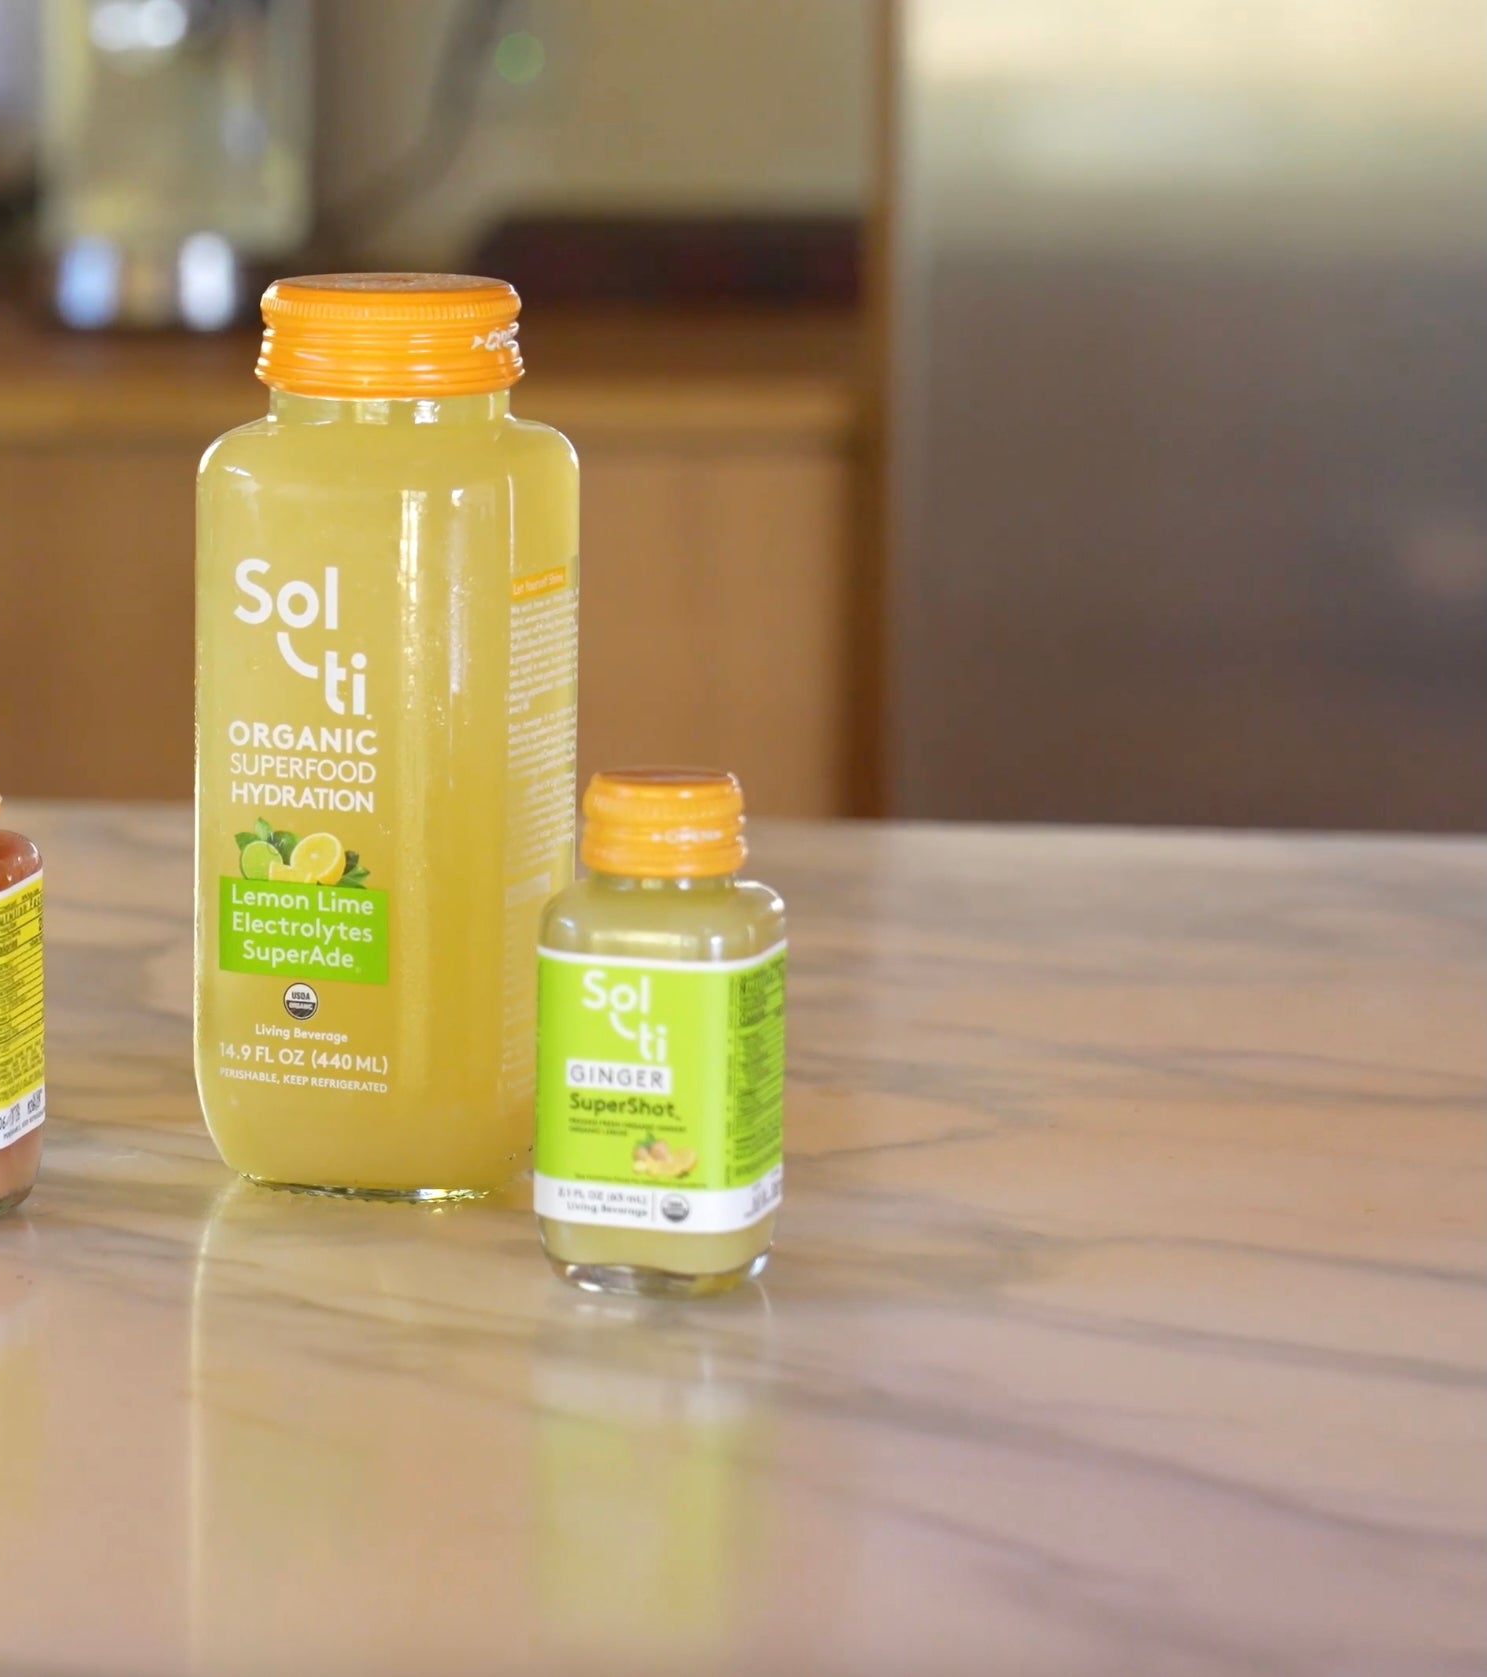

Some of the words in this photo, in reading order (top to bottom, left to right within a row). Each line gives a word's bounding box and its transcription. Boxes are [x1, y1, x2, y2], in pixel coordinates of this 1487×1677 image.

[233, 558, 338, 630] Sol
[228, 720, 378, 756] ORGANIC
[230, 753, 377, 784] SUPERFOOD
[232, 781, 374, 814] HYDRATION
[231, 884, 310, 910] Lemon
[317, 891, 374, 916] Lime
[232, 911, 373, 945] Electrolytes
[291, 991, 310, 1000] USDA
[581, 968, 650, 1015] Sol
[255, 1023, 290, 1040] Living
[293, 1028, 349, 1044] Beverage
[639, 1022, 667, 1062] ti
[219, 1042, 251, 1061] 14.9
[255, 1046, 275, 1063] FL
[278, 1048, 305, 1066] OZ
[311, 1049, 352, 1070] (440
[356, 1055, 388, 1075] ML)
[283, 1074, 309, 1086] KEEP
[311, 1076, 388, 1094] REFRIGERATED
[570, 1064, 663, 1088] GINGER
[567, 1201, 597, 1213] Living
[601, 1204, 647, 1217] Beverage
[588, 1190, 604, 1201] OZ
